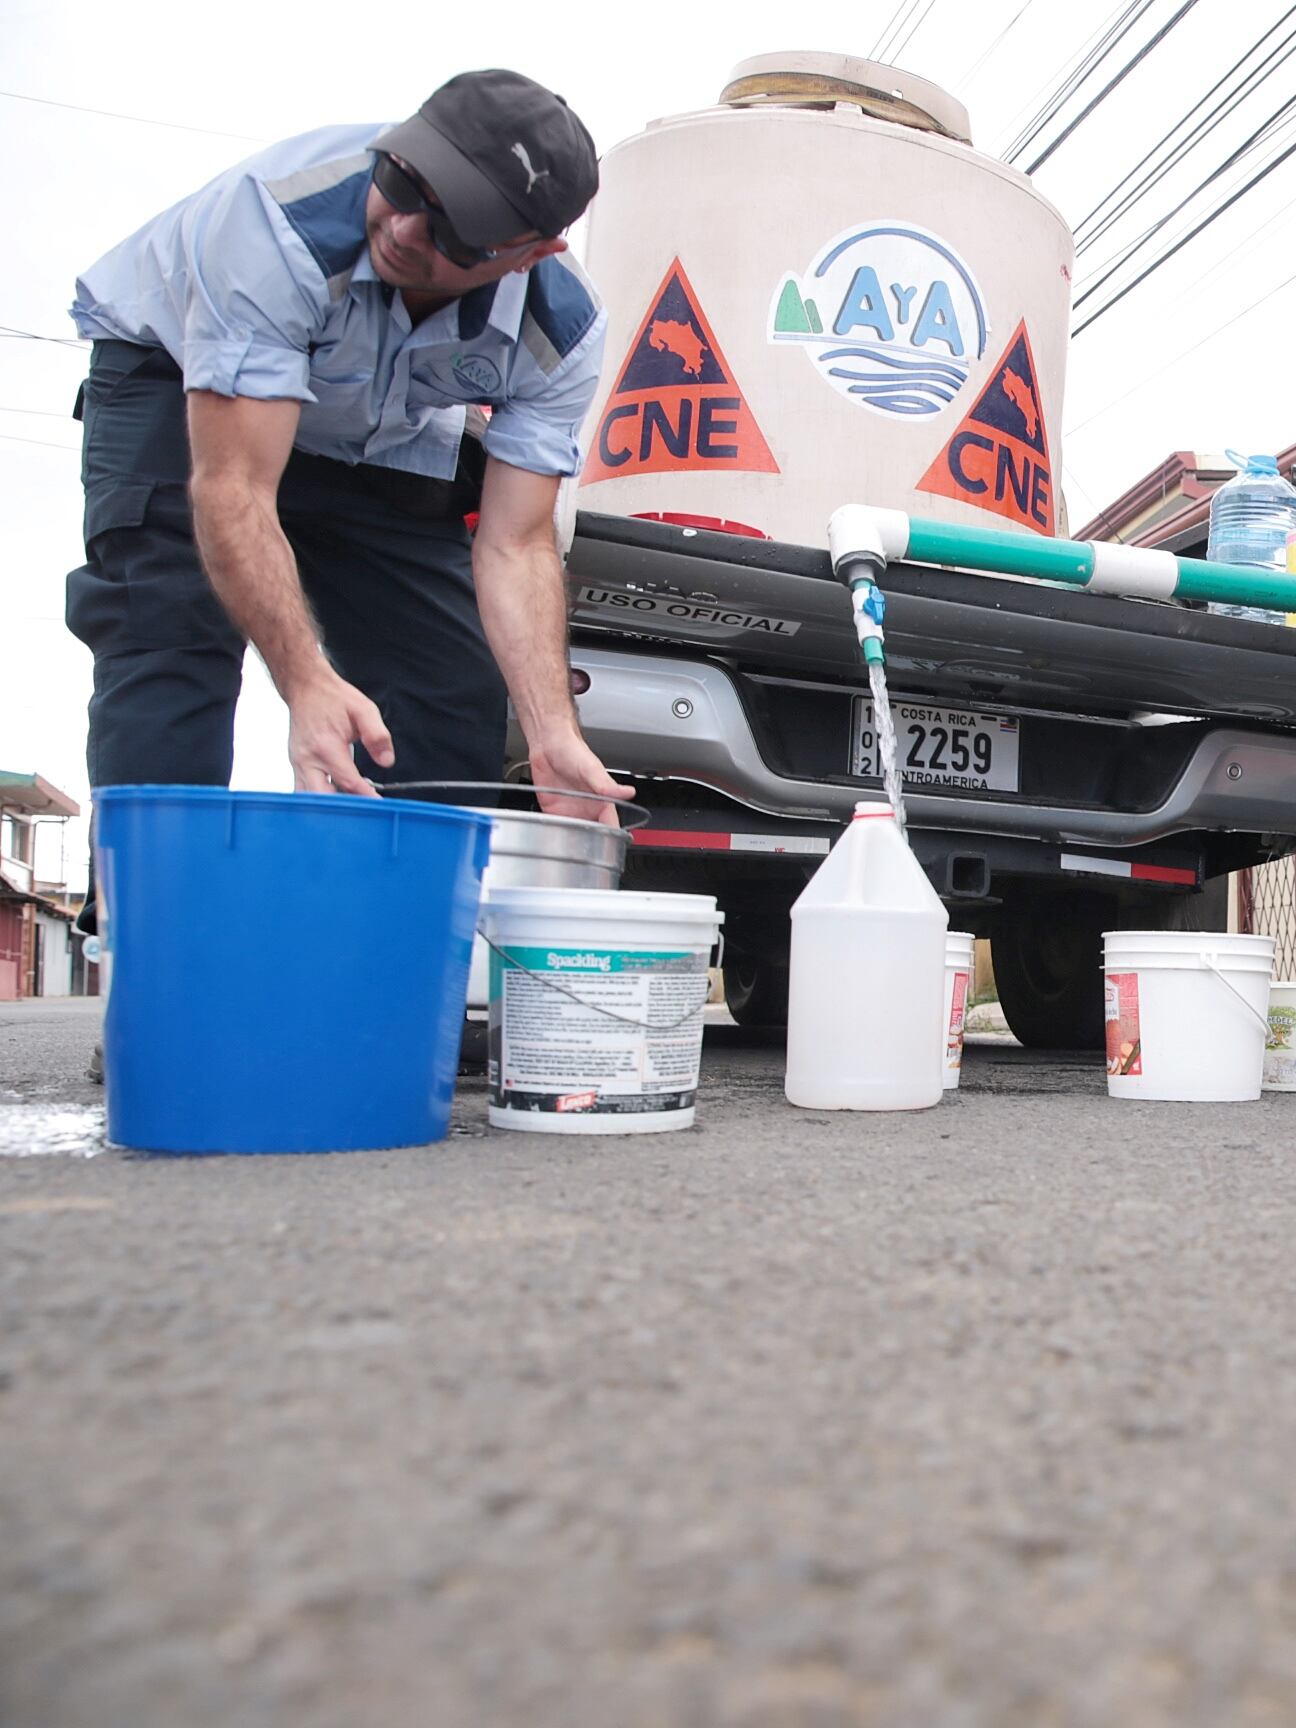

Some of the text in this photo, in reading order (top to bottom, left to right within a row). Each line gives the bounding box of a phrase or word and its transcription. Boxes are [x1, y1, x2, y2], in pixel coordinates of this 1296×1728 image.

[599, 398, 740, 467] CNE
[948, 431, 1049, 528] CNE
[586, 589, 790, 635] USO OFICIAL
[901, 707, 976, 727] COSTA RICA
[906, 724, 992, 774] 2259
[547, 952, 611, 971] Spackling
